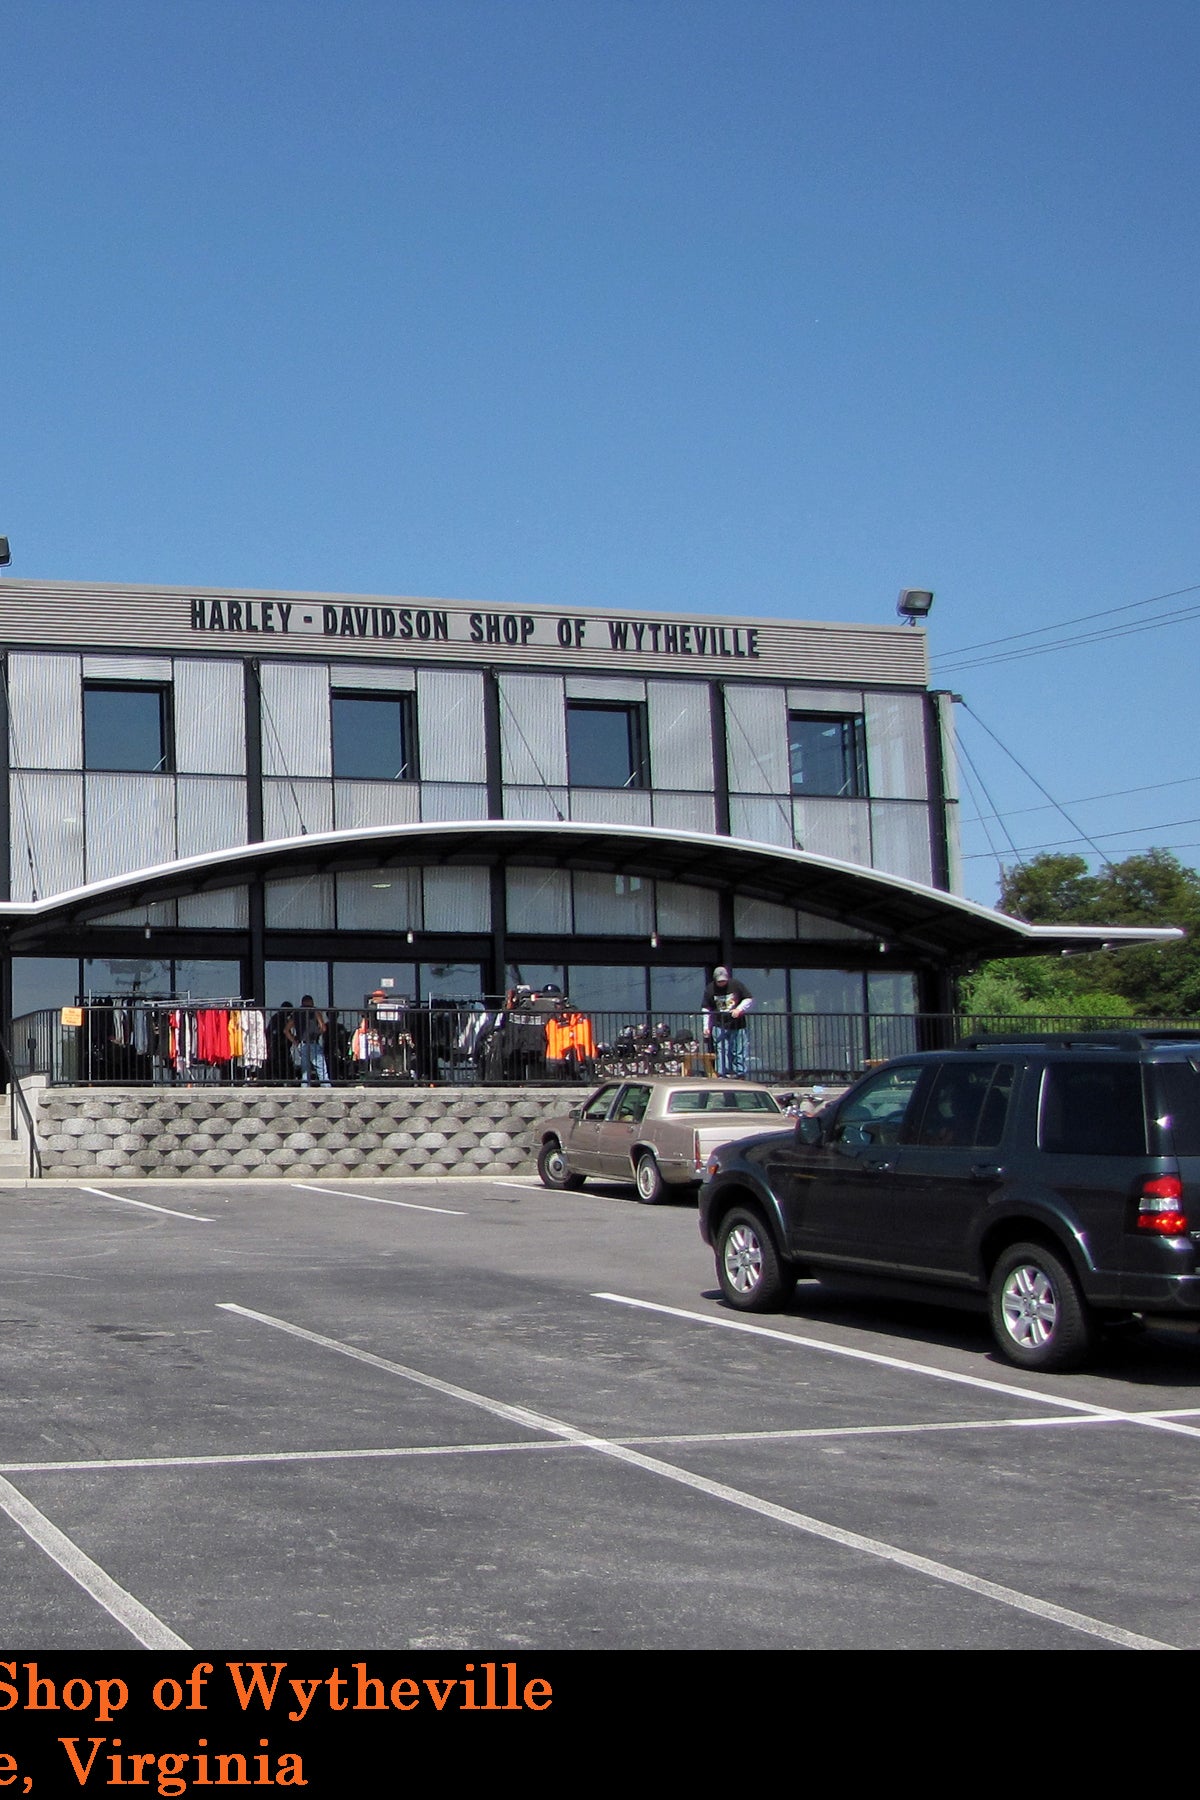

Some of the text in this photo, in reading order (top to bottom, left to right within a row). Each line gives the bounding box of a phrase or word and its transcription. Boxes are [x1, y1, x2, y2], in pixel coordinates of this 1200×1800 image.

[469, 613, 535, 646] SHOP
[557, 618, 586, 648] OF
[607, 621, 760, 658] WYTHEVILLE
